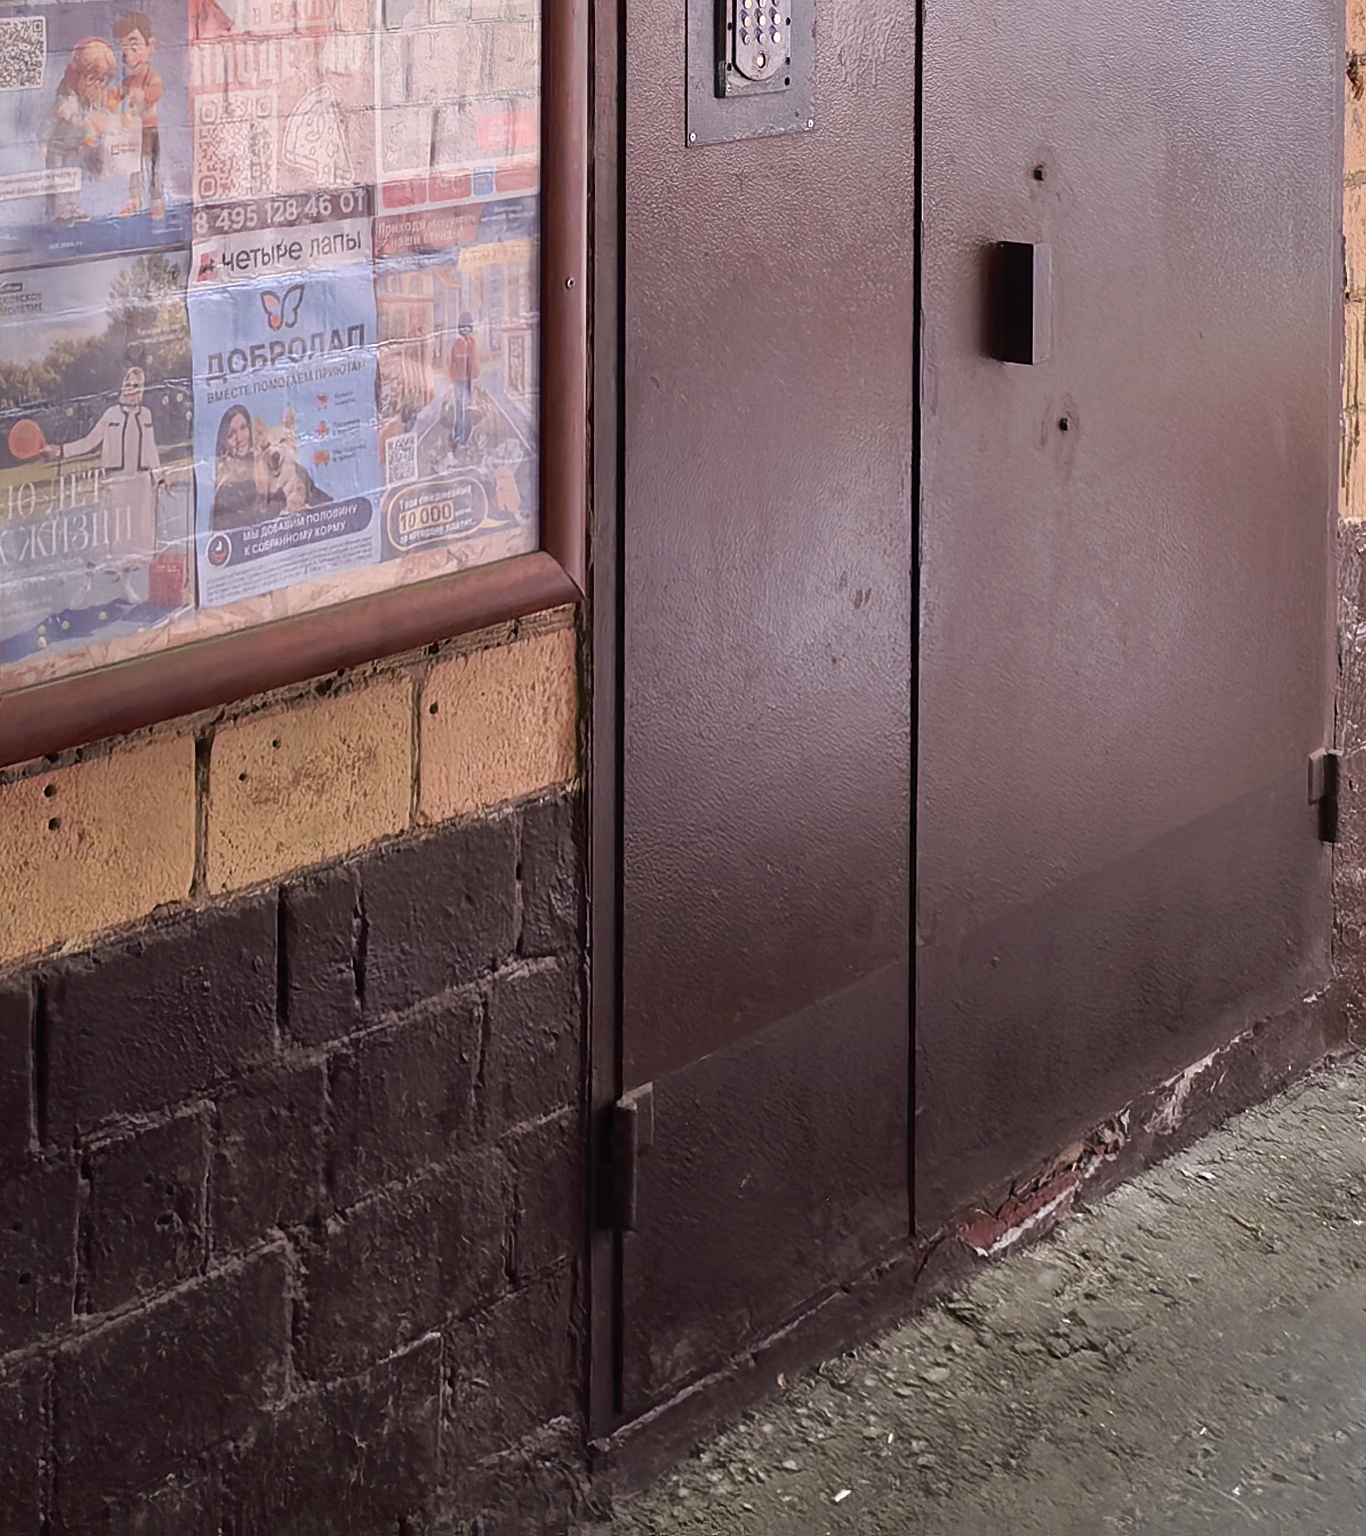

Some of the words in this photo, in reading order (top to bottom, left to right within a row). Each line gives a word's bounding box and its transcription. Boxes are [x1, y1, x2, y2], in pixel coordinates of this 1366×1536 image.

[195, 211, 209, 234] 8
[215, 206, 258, 231] 495
[265, 200, 298, 224] 128
[305, 194, 332, 217] 46
[339, 189, 365, 214] 01
[309, 231, 362, 258] лапы
[205, 323, 365, 387] ДОБРОЛАП
[207, 384, 251, 404] ВМЕСТЕ
[253, 371, 313, 393] ПОМОГАЕМ
[243, 528, 259, 541] МЫ
[306, 504, 358, 525] ПОЛОВИНУ
